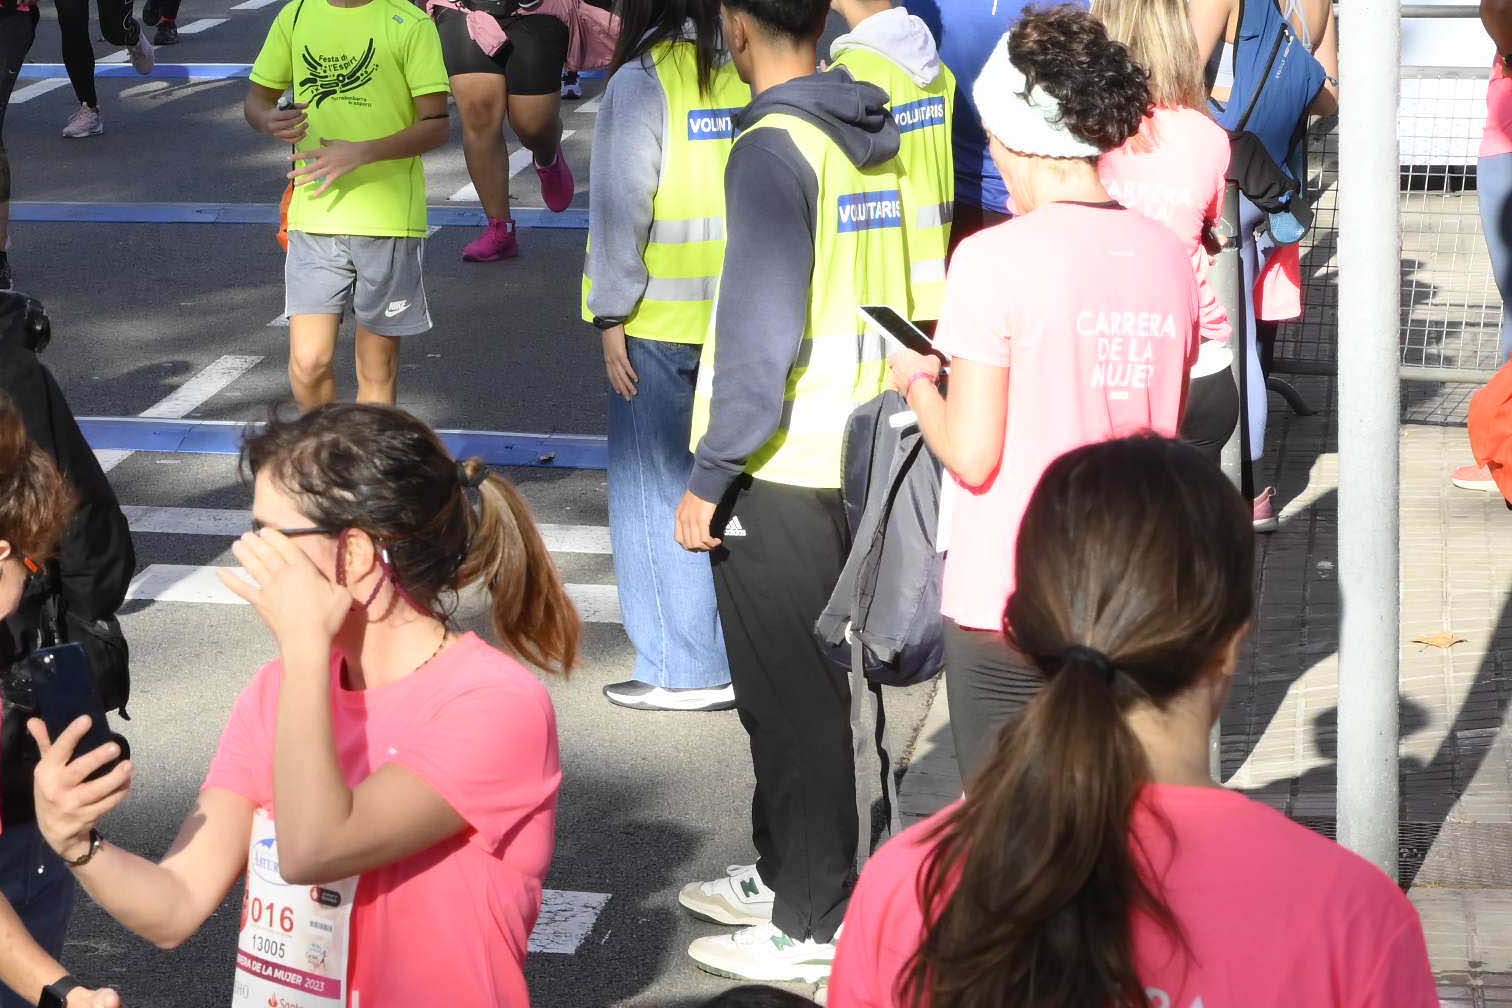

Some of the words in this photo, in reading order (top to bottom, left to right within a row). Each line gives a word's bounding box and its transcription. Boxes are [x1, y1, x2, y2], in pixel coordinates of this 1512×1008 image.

[1076, 310, 1177, 337] CARRERA
[1098, 338, 1123, 361] DE
[1128, 338, 1153, 361] LA
[251, 897, 294, 933] 016
[252, 934, 286, 959] 13005
[251, 962, 261, 973] DE
[262, 964, 273, 976] LA
[273, 967, 303, 985] MUJER
[304, 977, 325, 992] 2023
